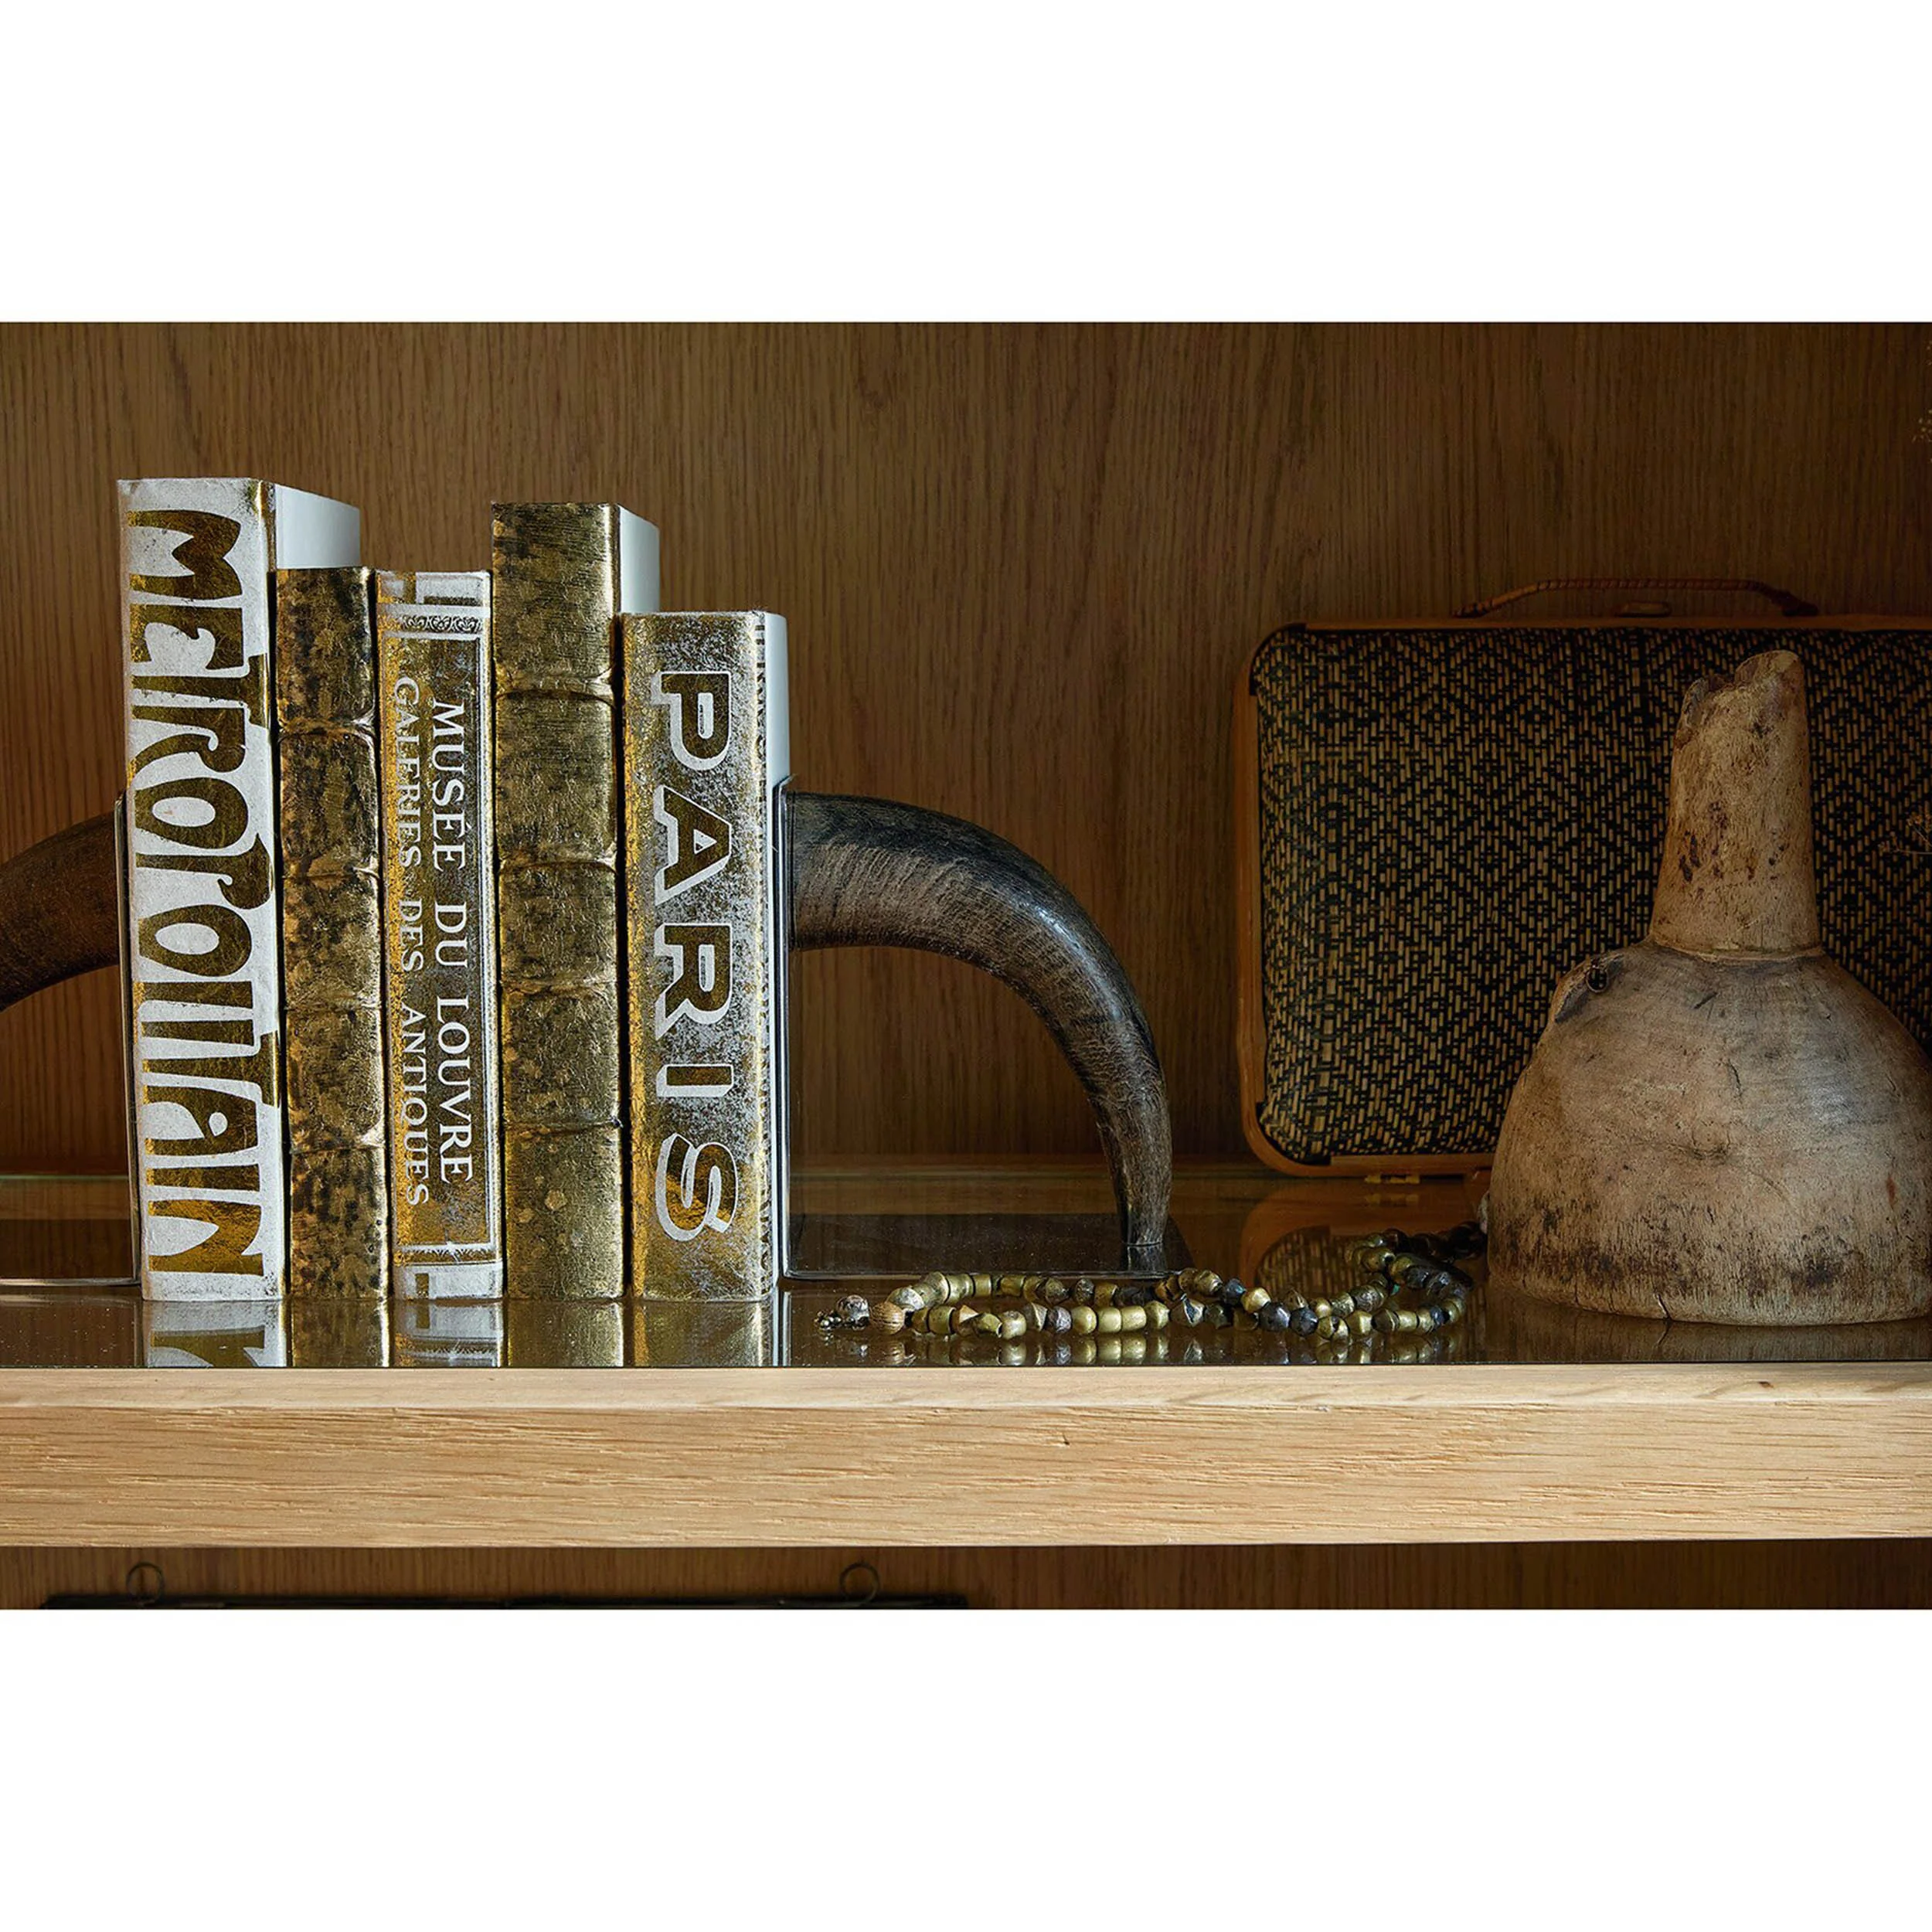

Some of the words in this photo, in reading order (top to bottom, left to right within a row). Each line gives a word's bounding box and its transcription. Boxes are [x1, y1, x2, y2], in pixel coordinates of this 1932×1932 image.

[393, 676, 423, 869] GALERIES
[432, 699, 472, 872] MUSÉE
[127, 510, 280, 1277] METROPOLITAIN
[398, 900, 424, 973] DES
[434, 901, 468, 968] DU
[651, 670, 739, 1242] PARIS
[400, 1005, 429, 1206] ANTIQUES
[435, 996, 473, 1184] LOUVRE
